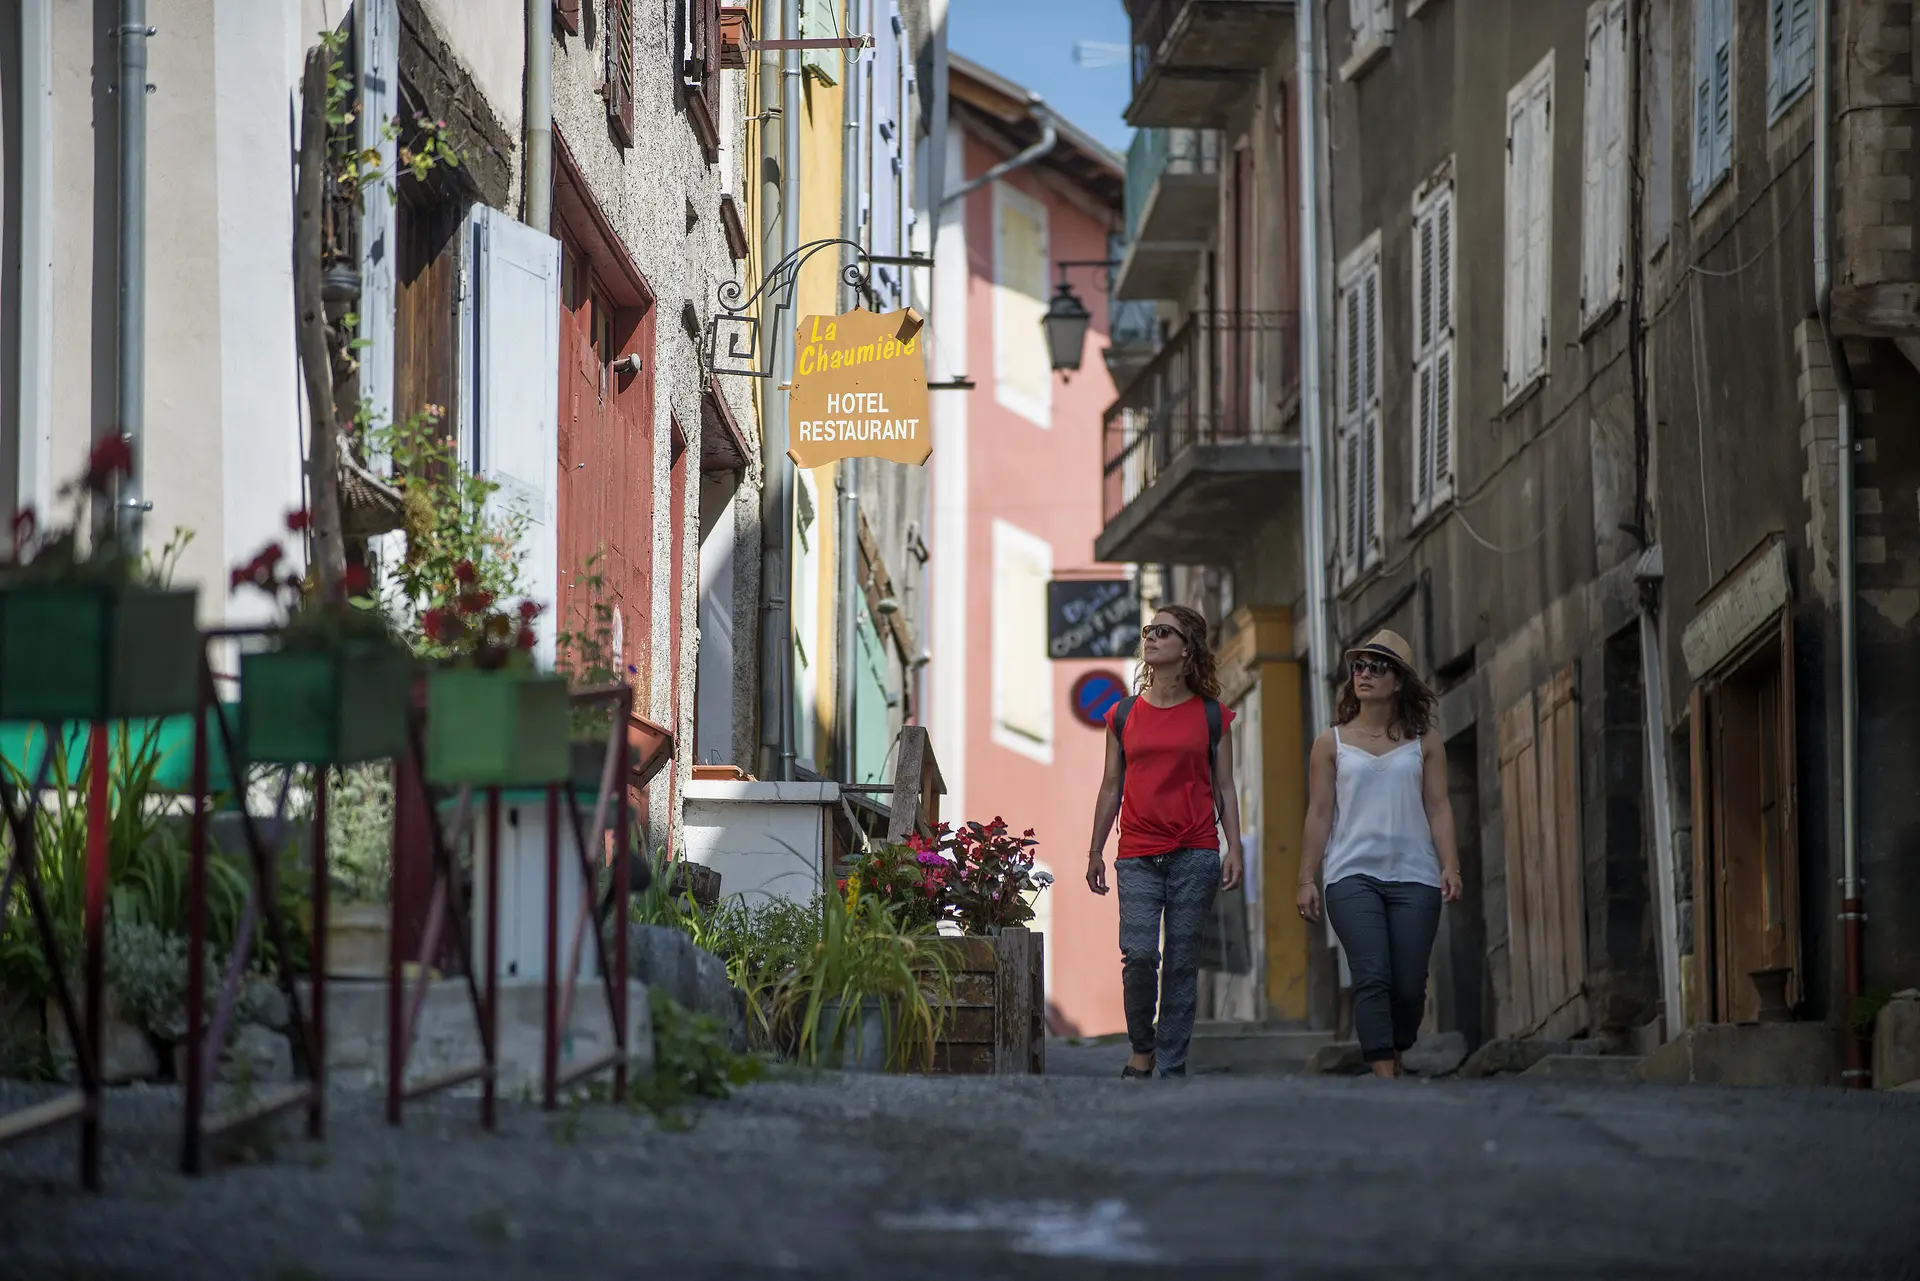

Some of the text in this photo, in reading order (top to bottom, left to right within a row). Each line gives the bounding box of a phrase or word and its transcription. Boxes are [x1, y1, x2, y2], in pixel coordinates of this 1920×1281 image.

[811, 315, 837, 343] La
[799, 334, 916, 376] Chaumière
[827, 392, 889, 414] HOTEL
[799, 418, 919, 442] RESTAURANT
